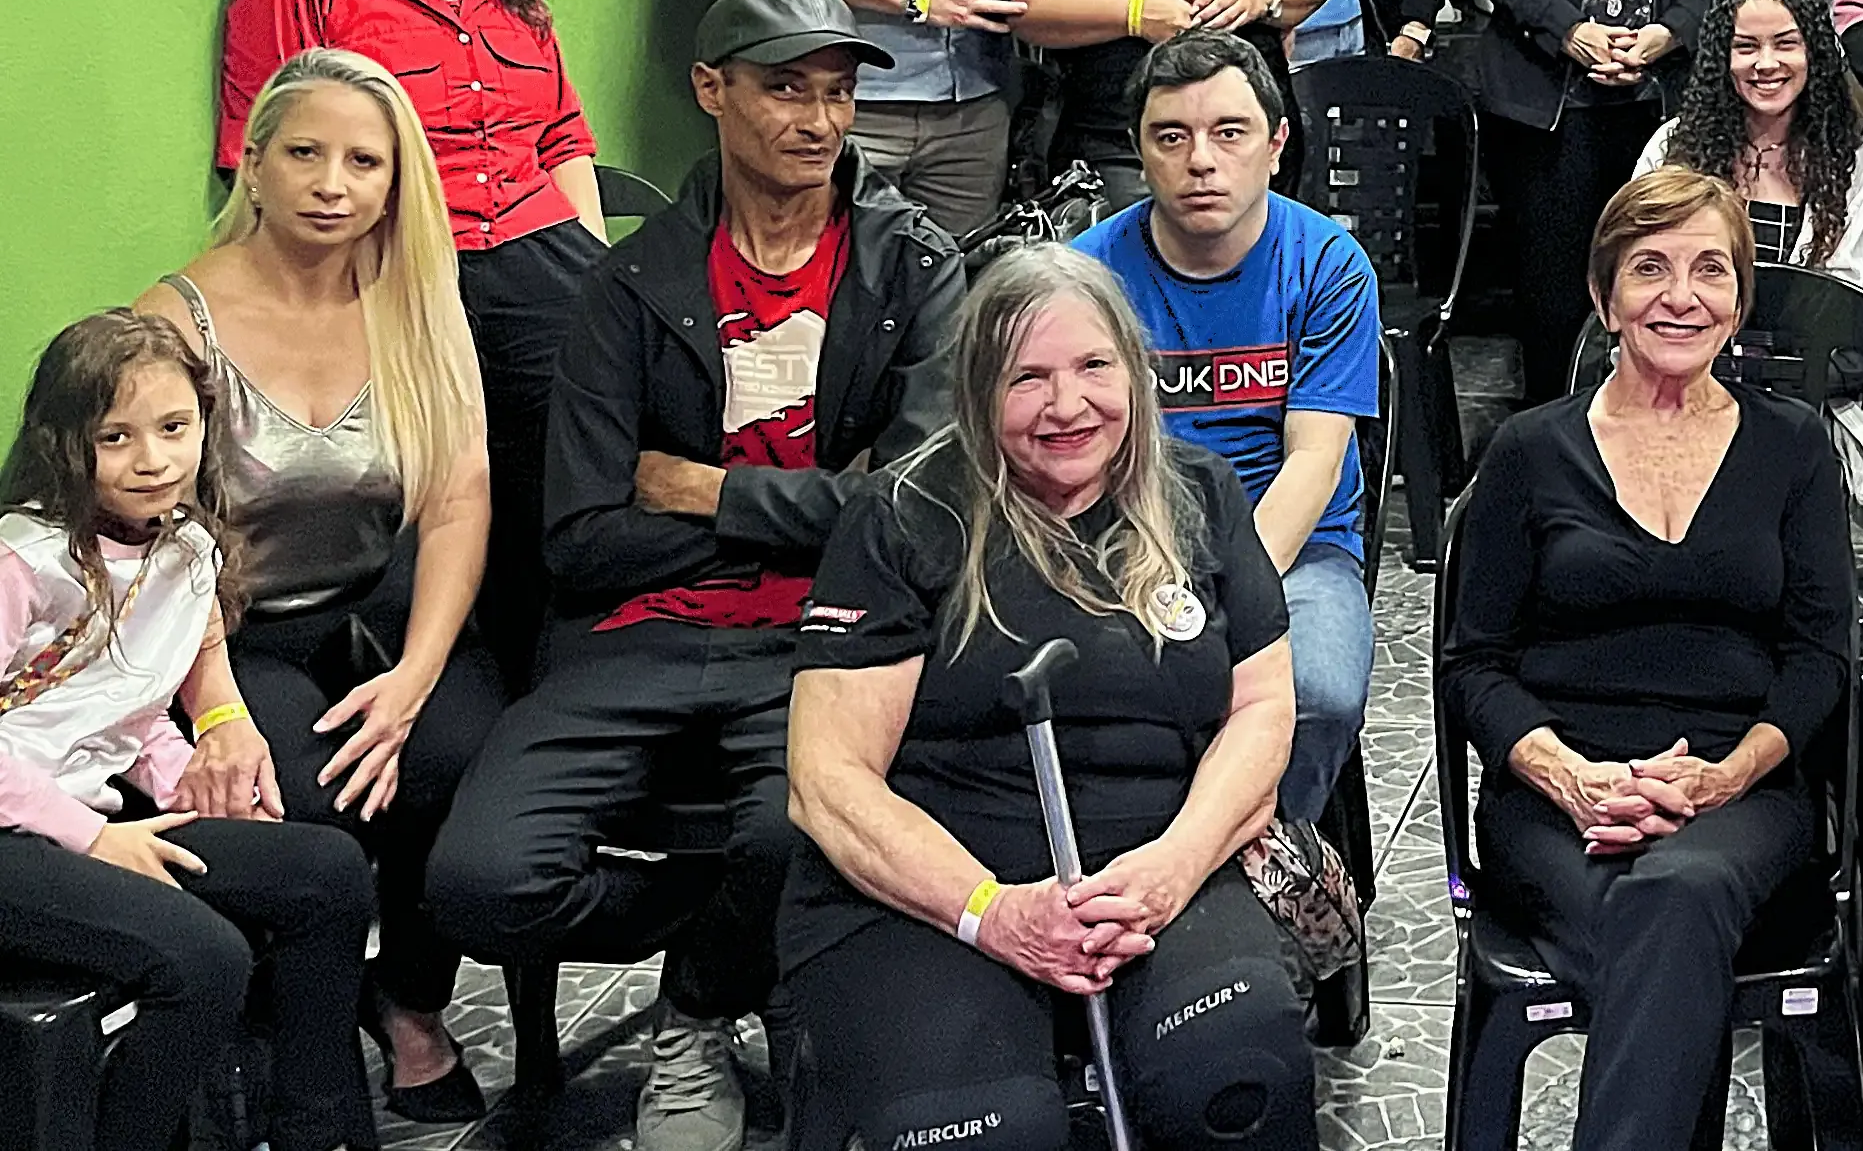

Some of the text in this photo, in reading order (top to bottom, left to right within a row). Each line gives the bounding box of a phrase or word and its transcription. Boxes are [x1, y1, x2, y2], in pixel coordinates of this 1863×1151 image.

[1219, 359, 1289, 391] DNB
[1156, 987, 1233, 1041] MERCUR
[891, 1119, 983, 1151] MERCUR
